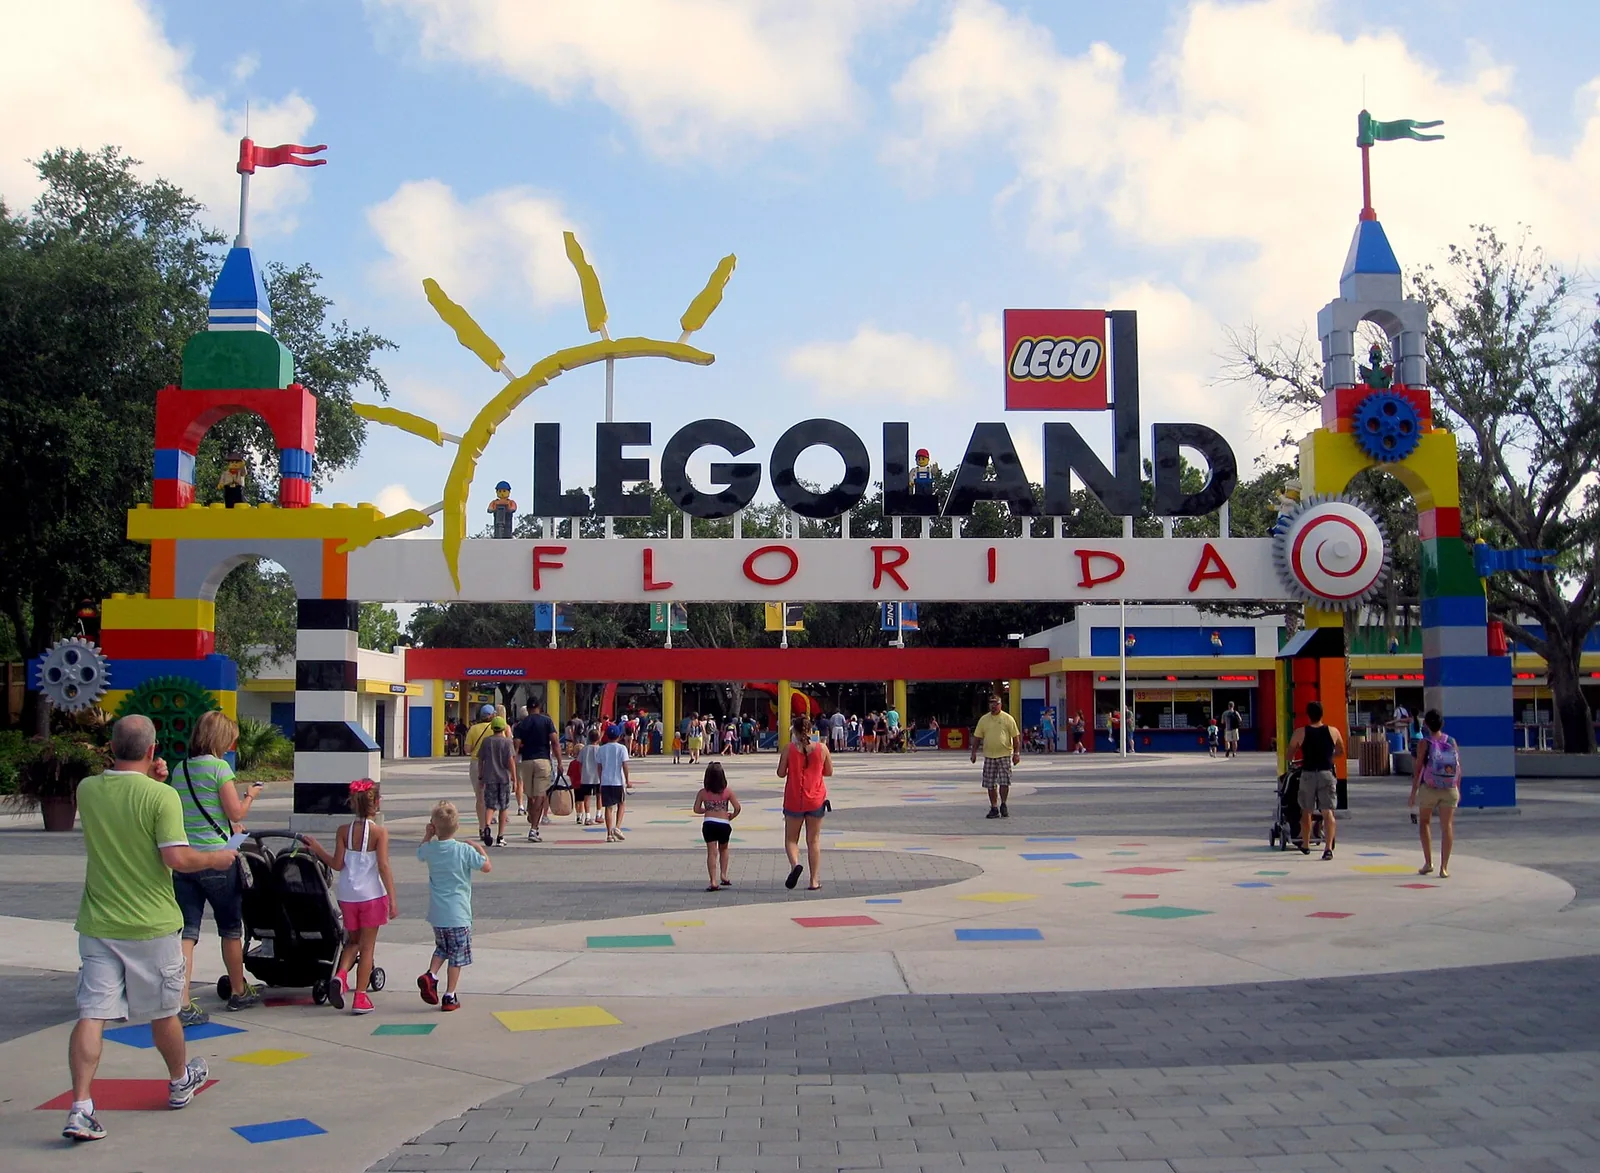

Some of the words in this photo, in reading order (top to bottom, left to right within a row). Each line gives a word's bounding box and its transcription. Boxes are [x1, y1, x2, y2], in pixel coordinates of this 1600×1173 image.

[1010, 338, 1102, 380] LEGO
[533, 418, 1238, 519] LEGOLAND
[532, 543, 1238, 592] FLORIDA
